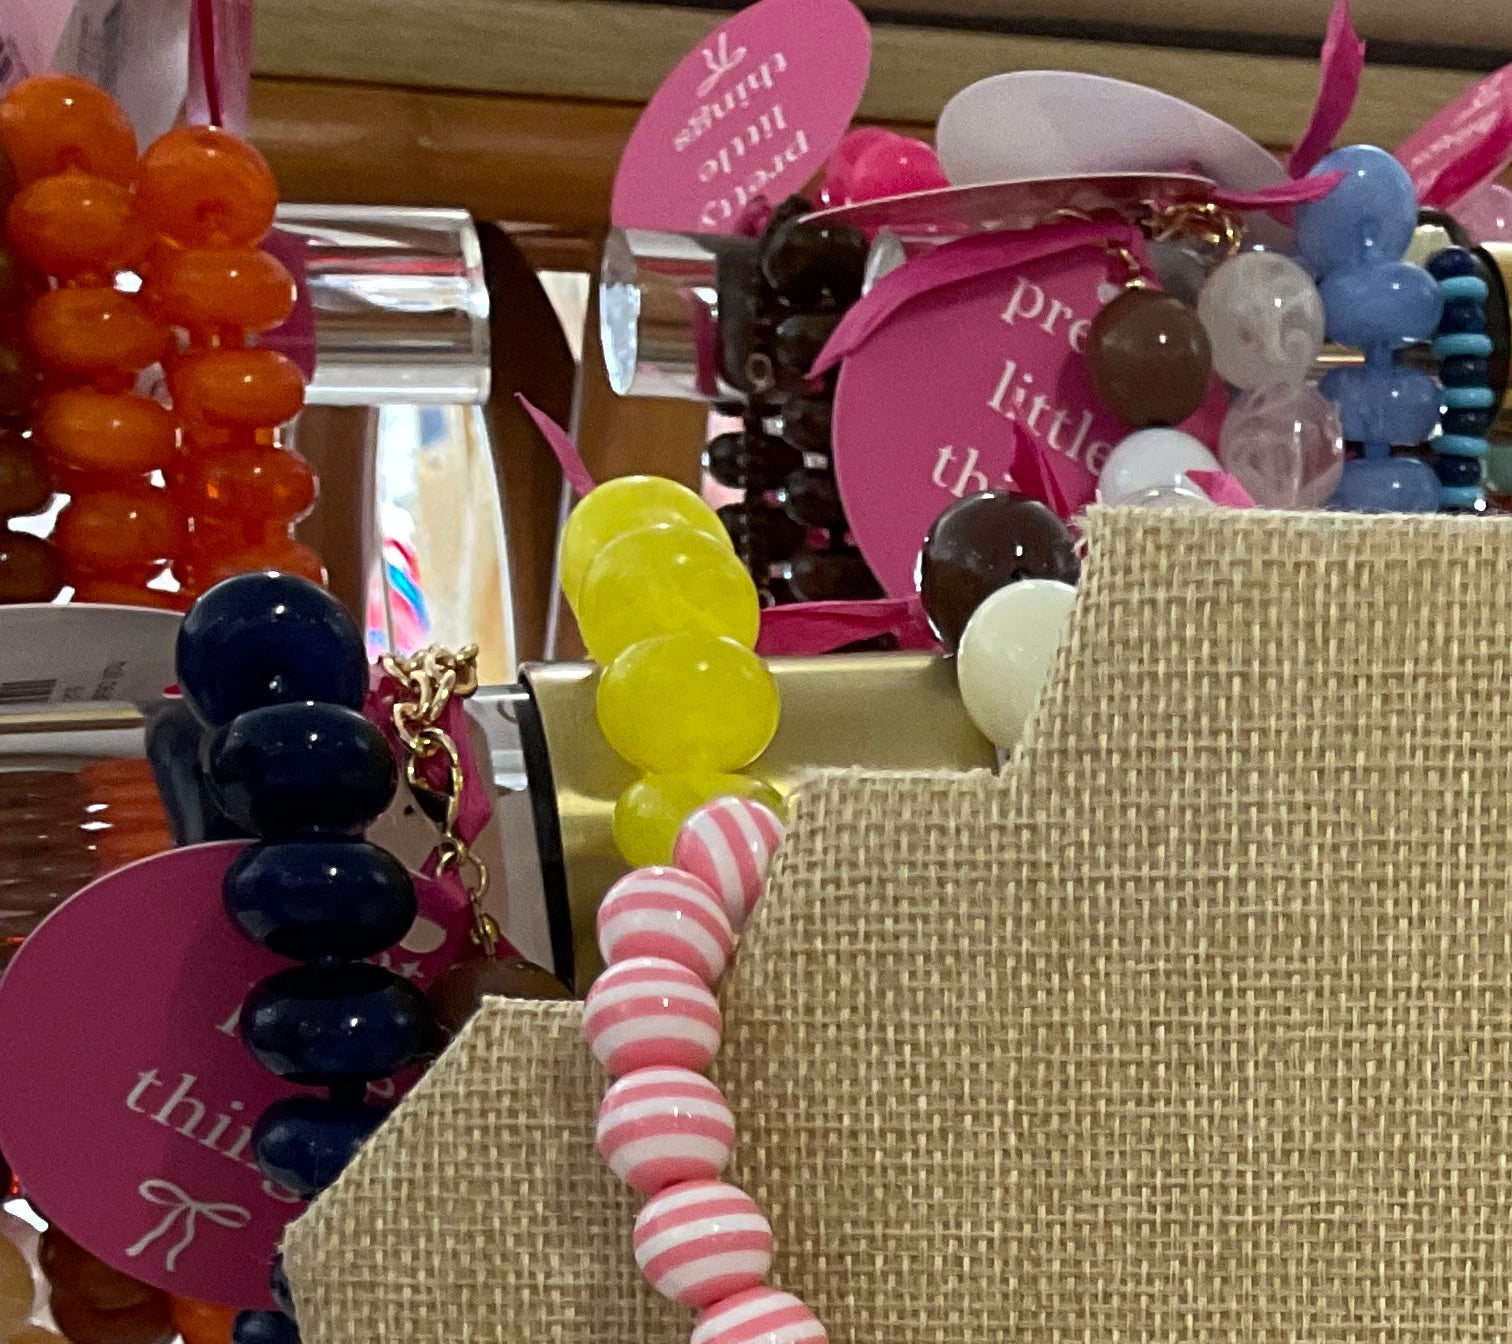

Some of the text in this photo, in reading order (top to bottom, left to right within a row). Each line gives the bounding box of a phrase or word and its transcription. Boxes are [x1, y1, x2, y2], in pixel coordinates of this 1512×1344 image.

[672, 52, 788, 152] things
[699, 104, 788, 183] little
[1000, 276, 1093, 354] pre
[987, 359, 1114, 478] little
